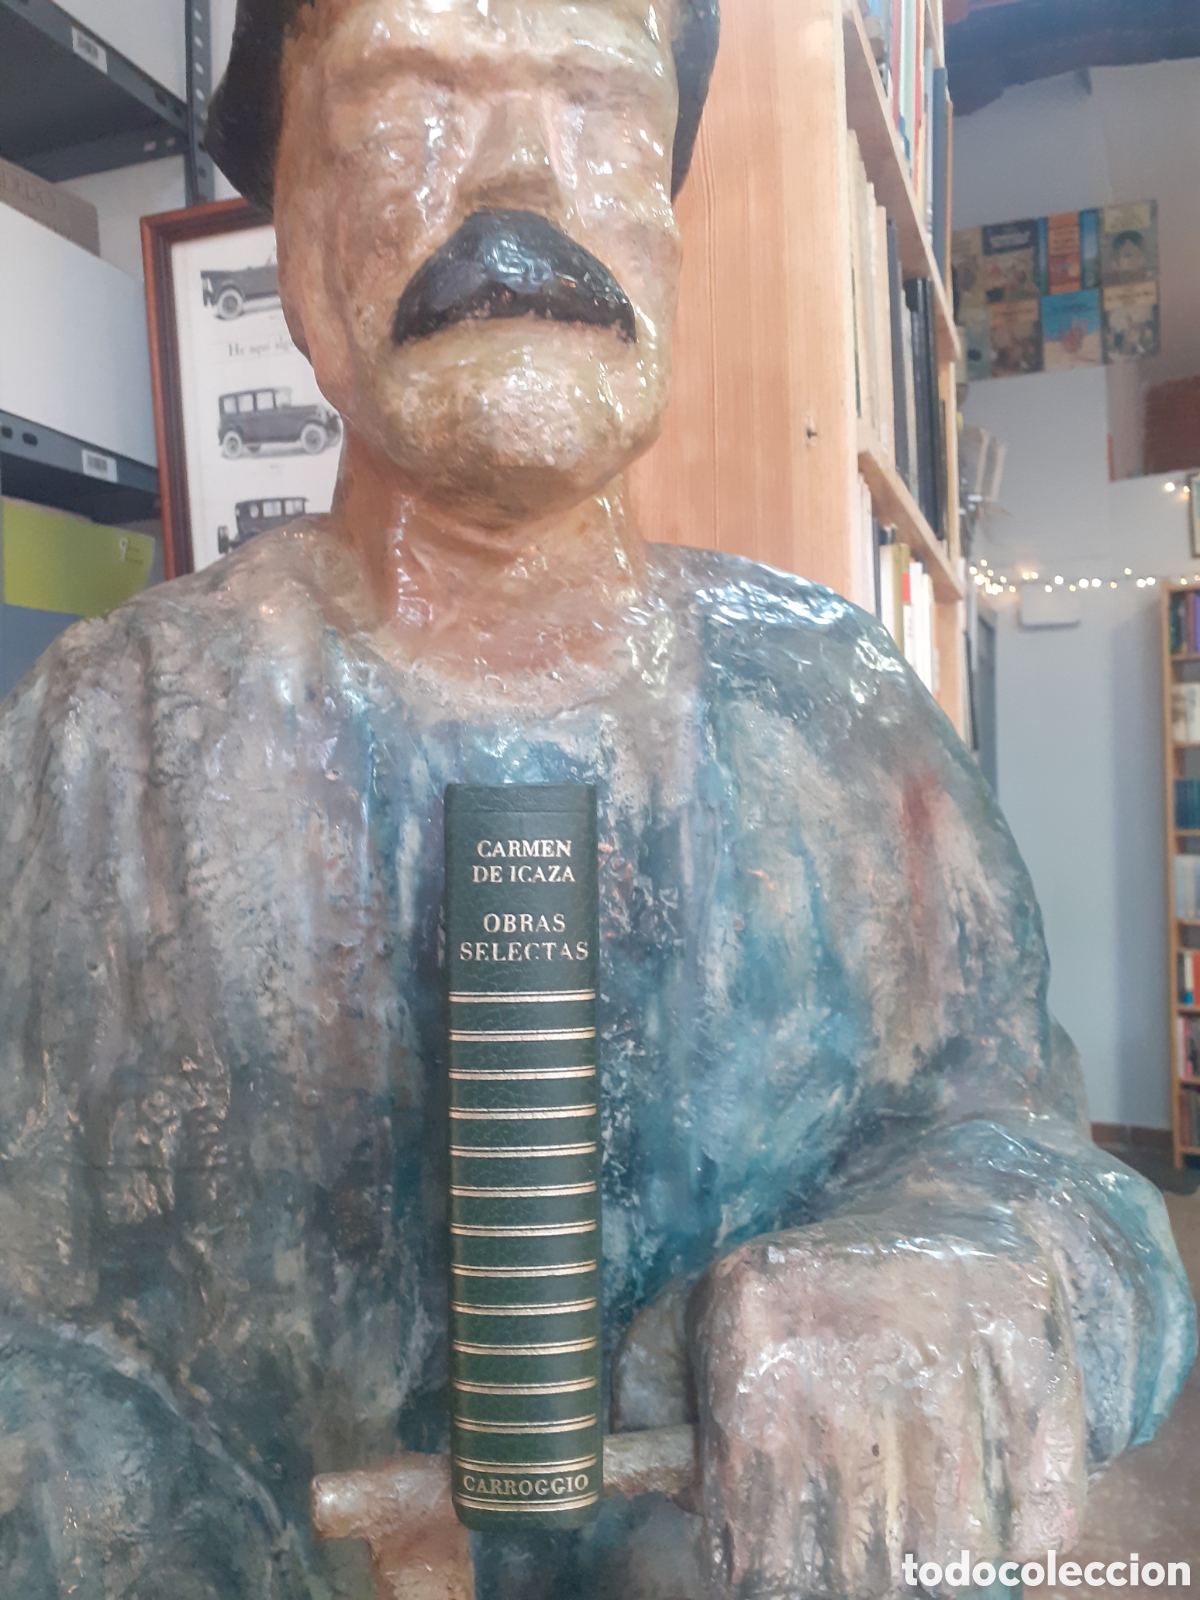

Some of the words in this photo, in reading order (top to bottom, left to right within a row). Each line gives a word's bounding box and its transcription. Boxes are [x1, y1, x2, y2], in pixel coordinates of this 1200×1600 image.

[476, 839, 572, 858] CARMEN
[472, 865, 503, 883] DE
[509, 865, 576, 883] ICAZA
[483, 913, 566, 933] OBRAS
[459, 941, 589, 962] SELECTAS
[463, 1474, 589, 1496] CARROGGIO
